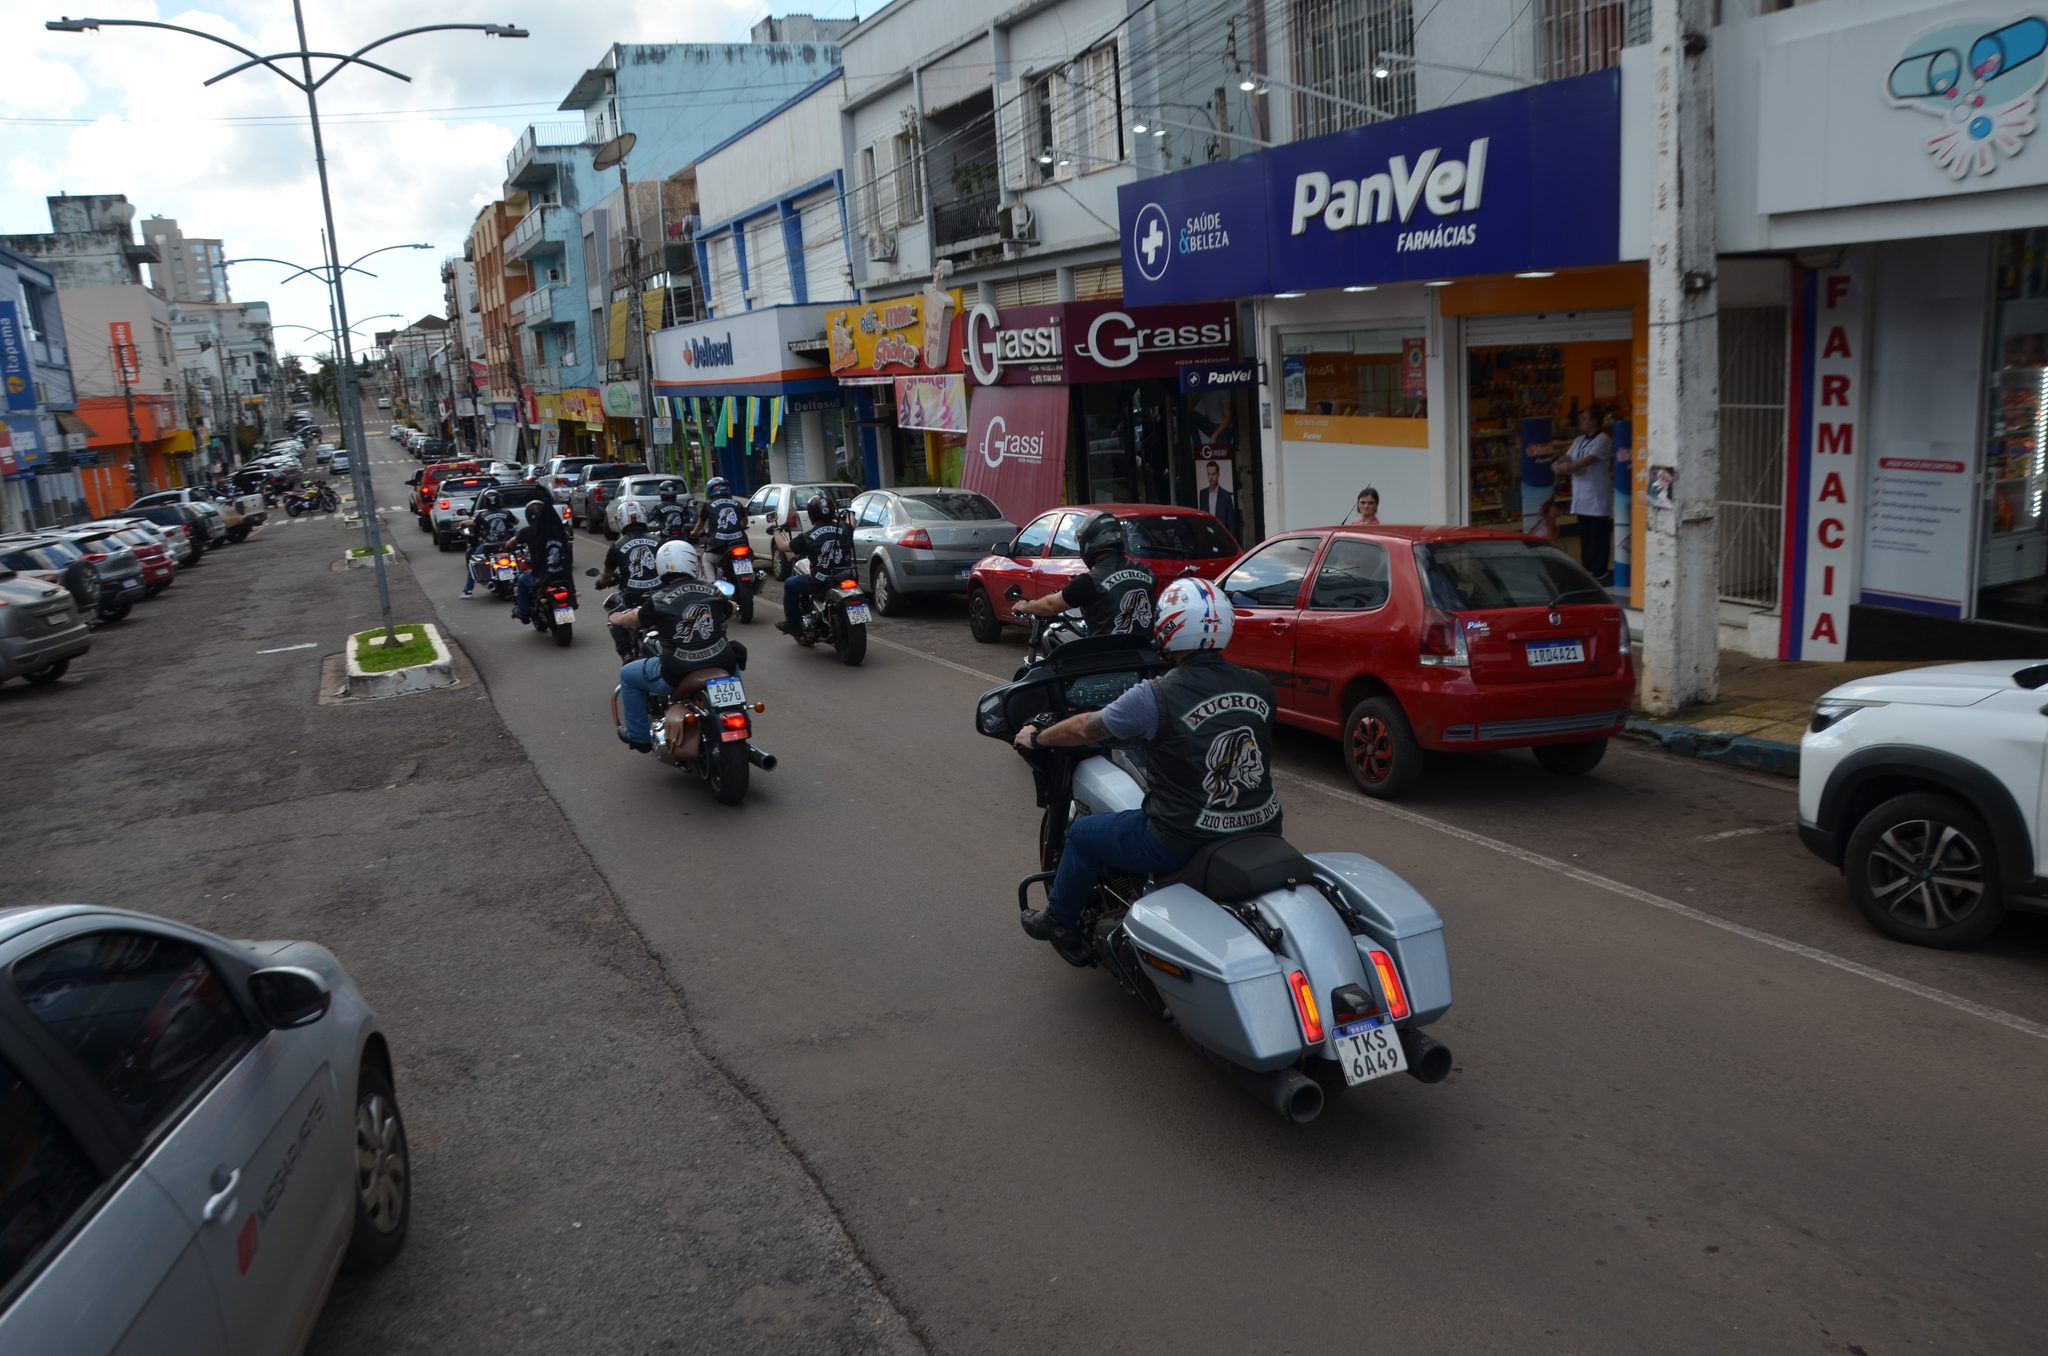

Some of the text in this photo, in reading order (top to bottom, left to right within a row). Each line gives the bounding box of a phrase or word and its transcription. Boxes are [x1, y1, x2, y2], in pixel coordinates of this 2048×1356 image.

[1291, 137, 1489, 235] PanVel
[1187, 212, 1222, 235] SAÚDE
[1397, 223, 1476, 252] FARMÁCIAS
[1190, 229, 1229, 252] BELEZA
[0, 317, 20, 373] itapema
[692, 331, 734, 368] Deltosul
[966, 304, 1062, 385] Grassi
[1087, 311, 1231, 367] Grassi
[1208, 369, 1252, 384] PanVel
[794, 400, 840, 412] Deltosul
[984, 416, 1044, 468] Grassi
[1810, 275, 1854, 645] FARMACIA
[666, 584, 713, 600] XUCROS
[1105, 570, 1152, 587] XUCROS
[1188, 695, 1268, 724] XUCROS
[1201, 816, 1220, 829] RIO
[1222, 811, 1263, 829] GRANDE
[1264, 806, 1274, 822] DO
[1349, 1029, 1388, 1056] TKS
[1353, 1048, 1398, 1079] 6A49
